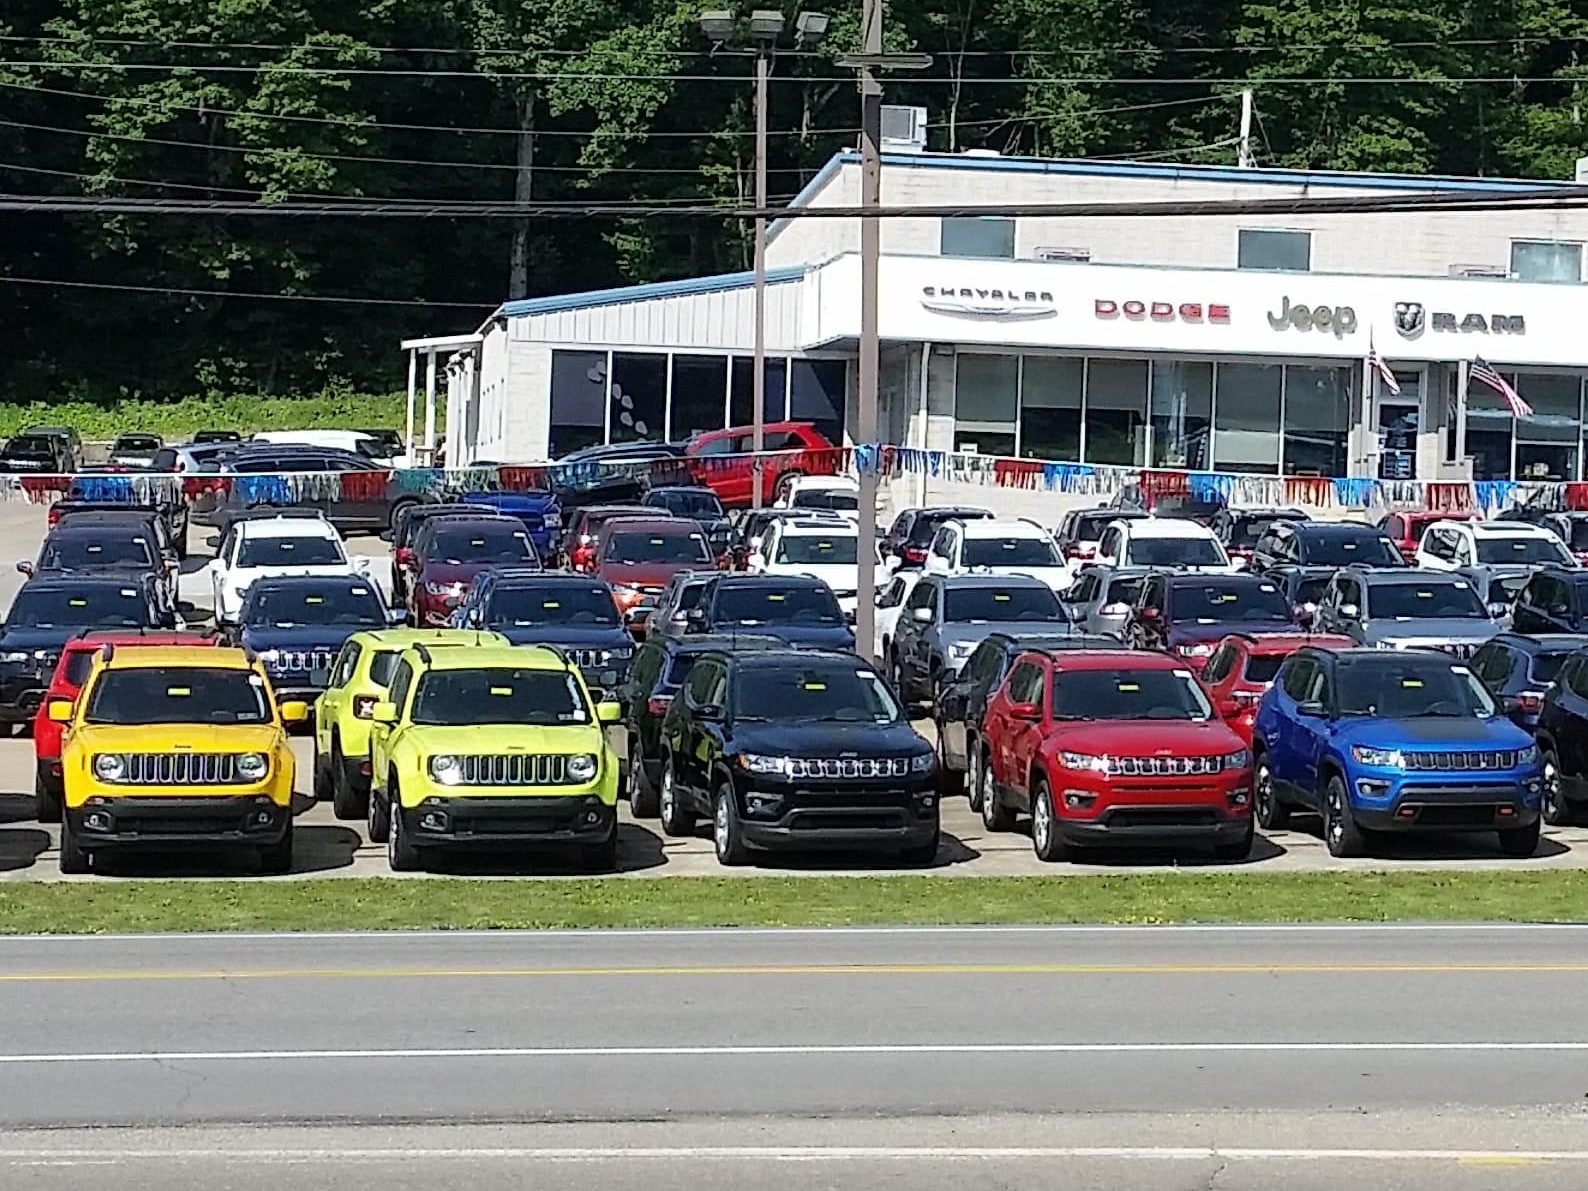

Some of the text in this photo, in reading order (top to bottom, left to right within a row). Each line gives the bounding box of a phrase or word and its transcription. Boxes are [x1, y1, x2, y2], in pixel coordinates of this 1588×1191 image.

[922, 286, 1054, 302] CHRYSLER
[1095, 299, 1231, 323] DODGE
[1267, 295, 1357, 339] Jeep
[1432, 312, 1525, 335] RAM
